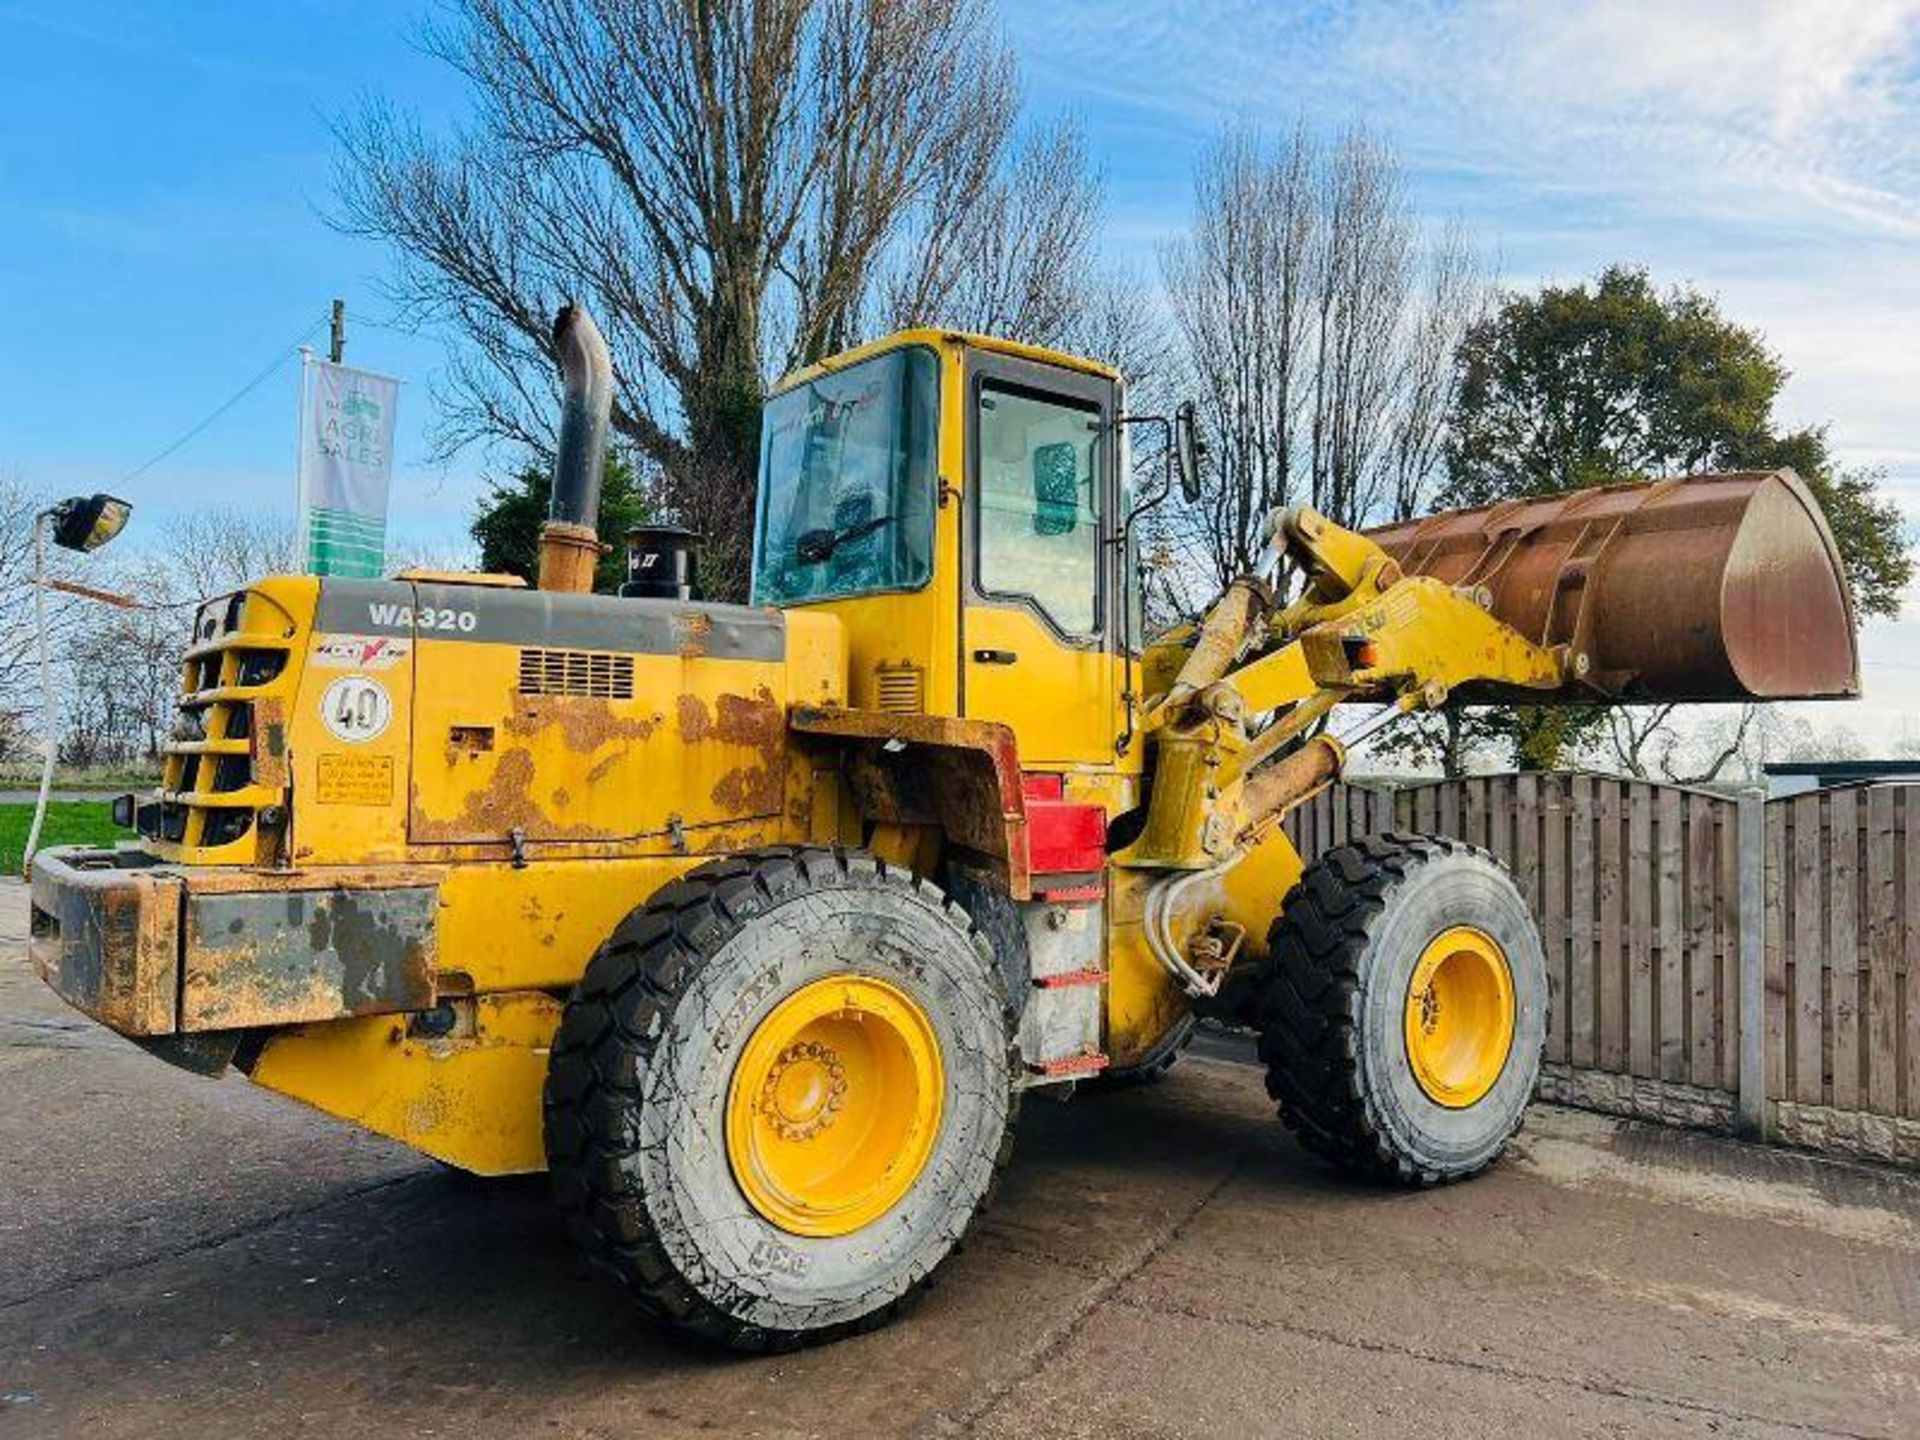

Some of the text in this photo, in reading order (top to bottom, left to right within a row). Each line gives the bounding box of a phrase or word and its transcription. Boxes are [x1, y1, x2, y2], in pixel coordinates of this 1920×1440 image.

[318, 439, 382, 466] SALES
[368, 602, 476, 632] WA320
[336, 687, 377, 729] 40
